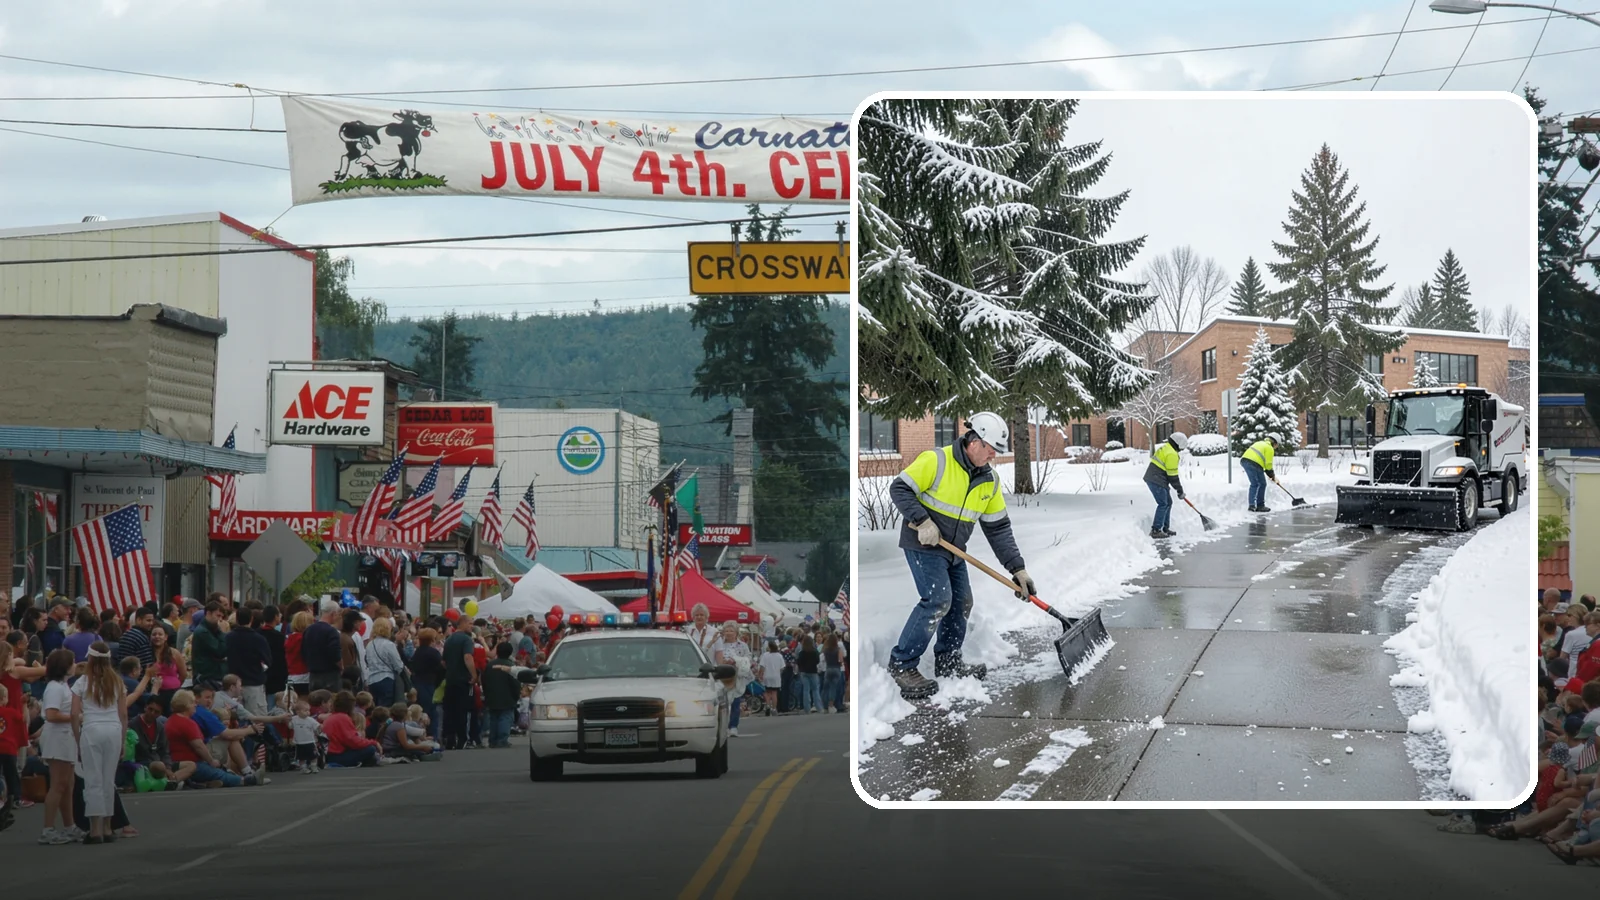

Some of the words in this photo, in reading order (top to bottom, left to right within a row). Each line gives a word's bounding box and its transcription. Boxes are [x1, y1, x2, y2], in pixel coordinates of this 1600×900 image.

[695, 121, 850, 150] Carnat
[482, 141, 604, 192] JULY
[632, 151, 746, 197] 4th.
[697, 255, 850, 280] CROSSWA
[283, 380, 373, 420] ACE
[405, 409, 452, 422] CEDAR
[284, 421, 371, 436] Hardware
[95, 485, 125, 494] Vincent
[126, 486, 136, 494] de
[138, 486, 155, 495] Paul
[212, 516, 331, 535] HARDARE
[688, 526, 742, 535] CRNATION
[699, 535, 730, 543] GLASS
